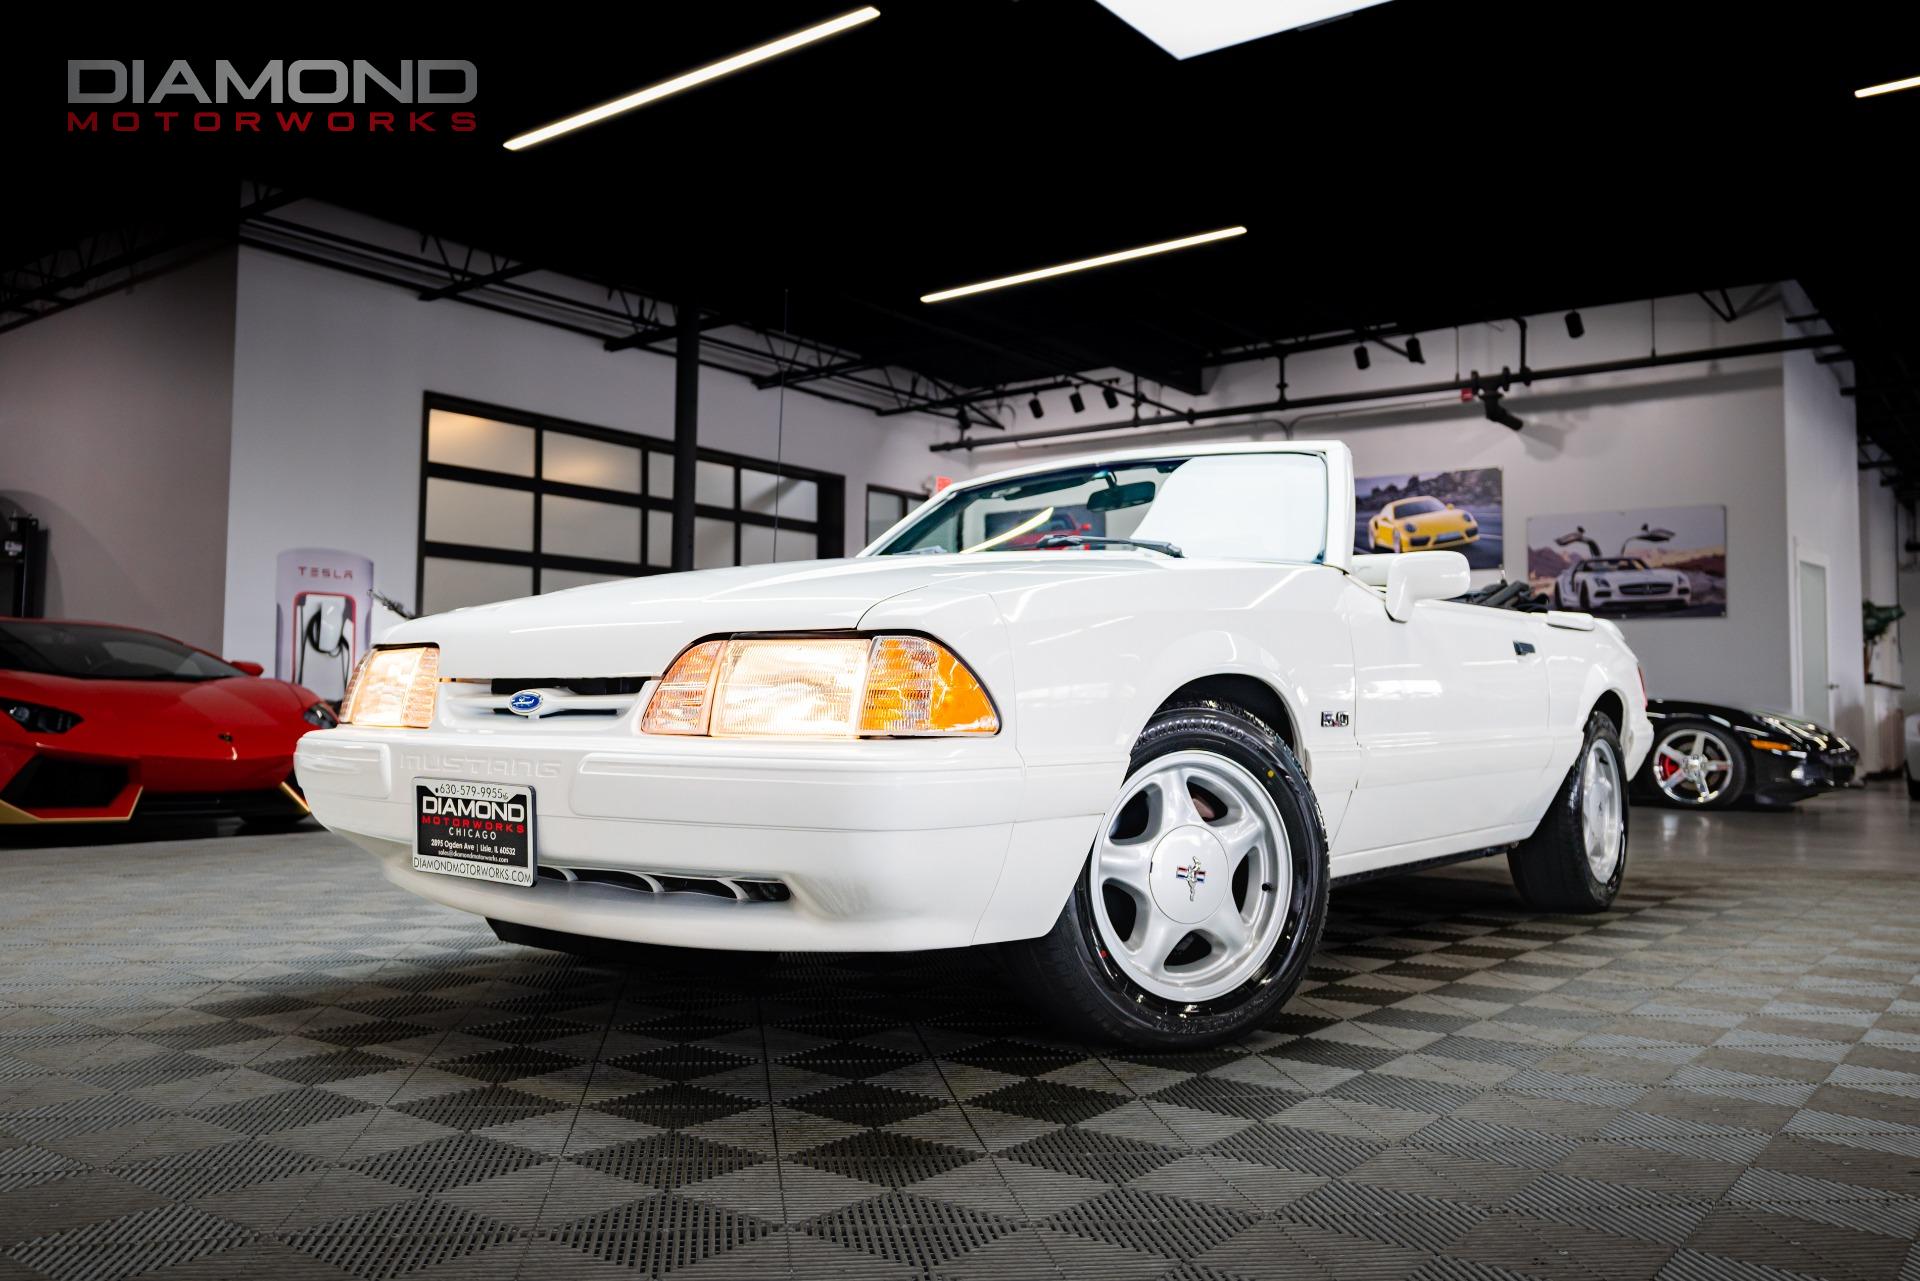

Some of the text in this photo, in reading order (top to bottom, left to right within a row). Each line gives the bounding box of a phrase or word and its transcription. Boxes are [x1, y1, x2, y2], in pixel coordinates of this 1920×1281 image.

[298, 566, 353, 580] TESLA
[1321, 711, 1349, 727] 5.0
[400, 753, 561, 778] MUSTANG
[439, 784, 503, 799] 630-579-9955
[422, 795, 525, 822] DIAMOND
[421, 816, 525, 834] MOTORWORKS
[449, 827, 497, 840] CHICAGO
[430, 838, 444, 847] 2895
[444, 840, 463, 850] Ogden
[463, 842, 475, 851] Ave
[499, 846, 516, 856] 60532
[413, 856, 532, 884] DIAMONDMOTORWORKS.COM
